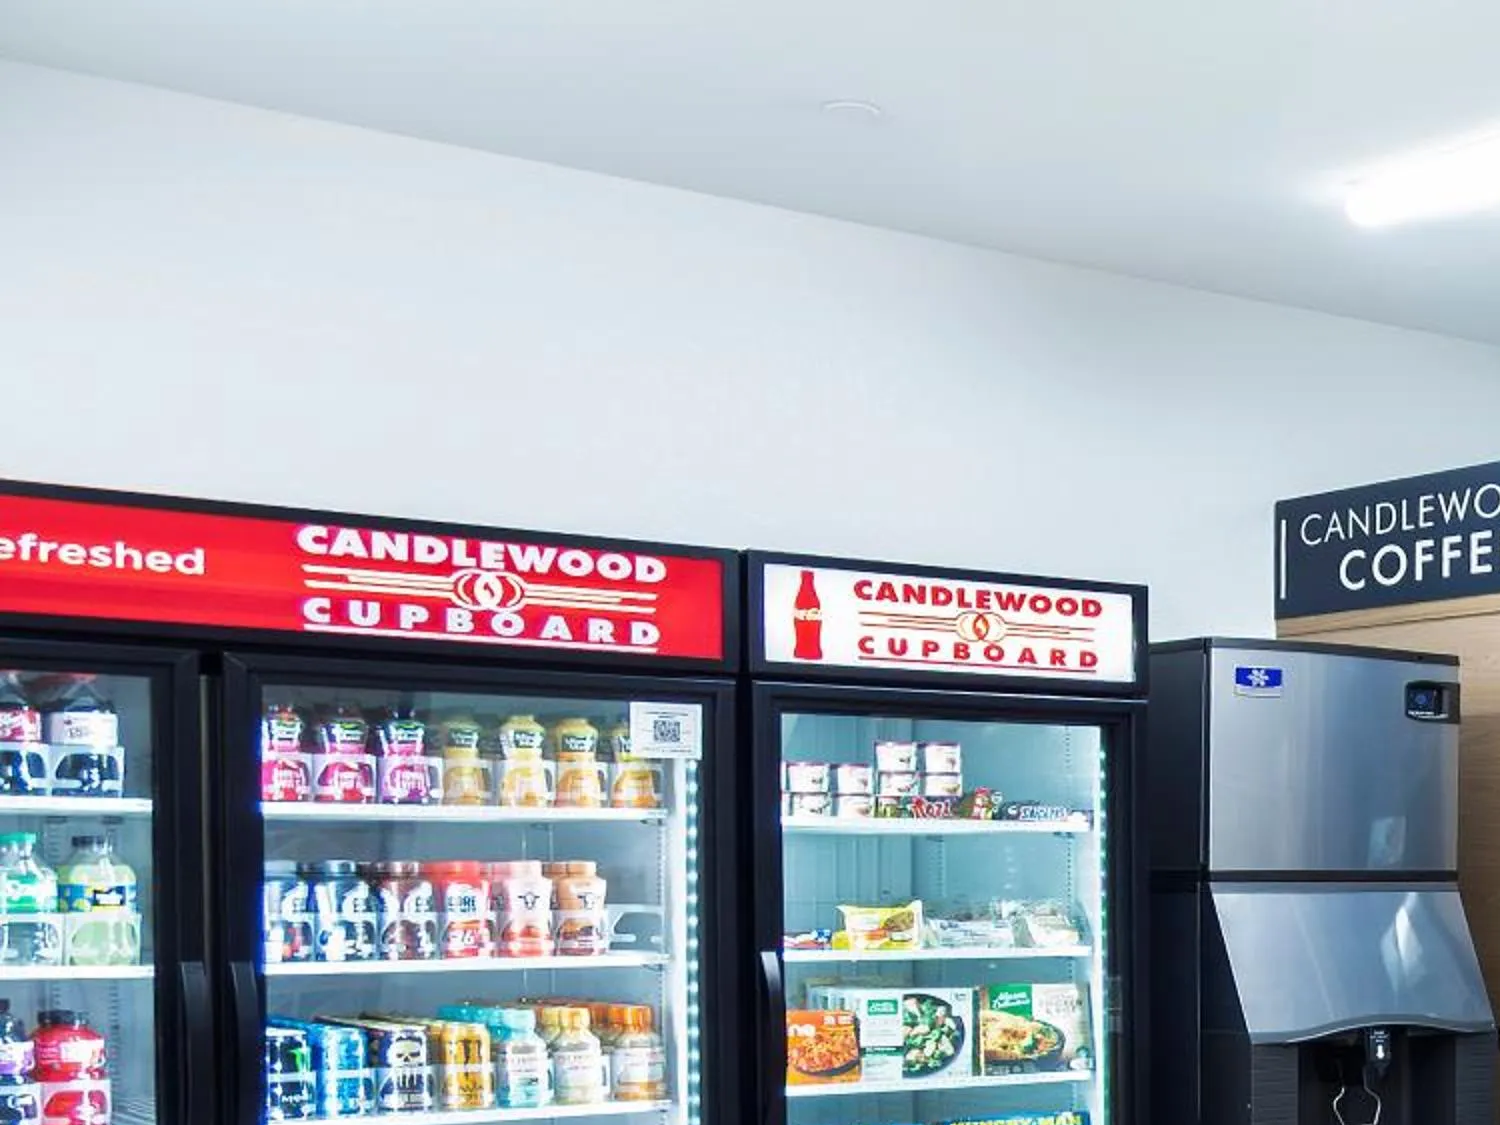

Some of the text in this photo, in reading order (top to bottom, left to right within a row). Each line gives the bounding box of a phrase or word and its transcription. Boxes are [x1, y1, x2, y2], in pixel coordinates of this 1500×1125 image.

[0, 532, 206, 576] efreshed
[297, 525, 667, 583] CANDLEWOOD
[853, 580, 1103, 618] CANDLEWOOD
[303, 597, 661, 646] CUPBOARD
[857, 635, 1099, 668] CUPBOARD
